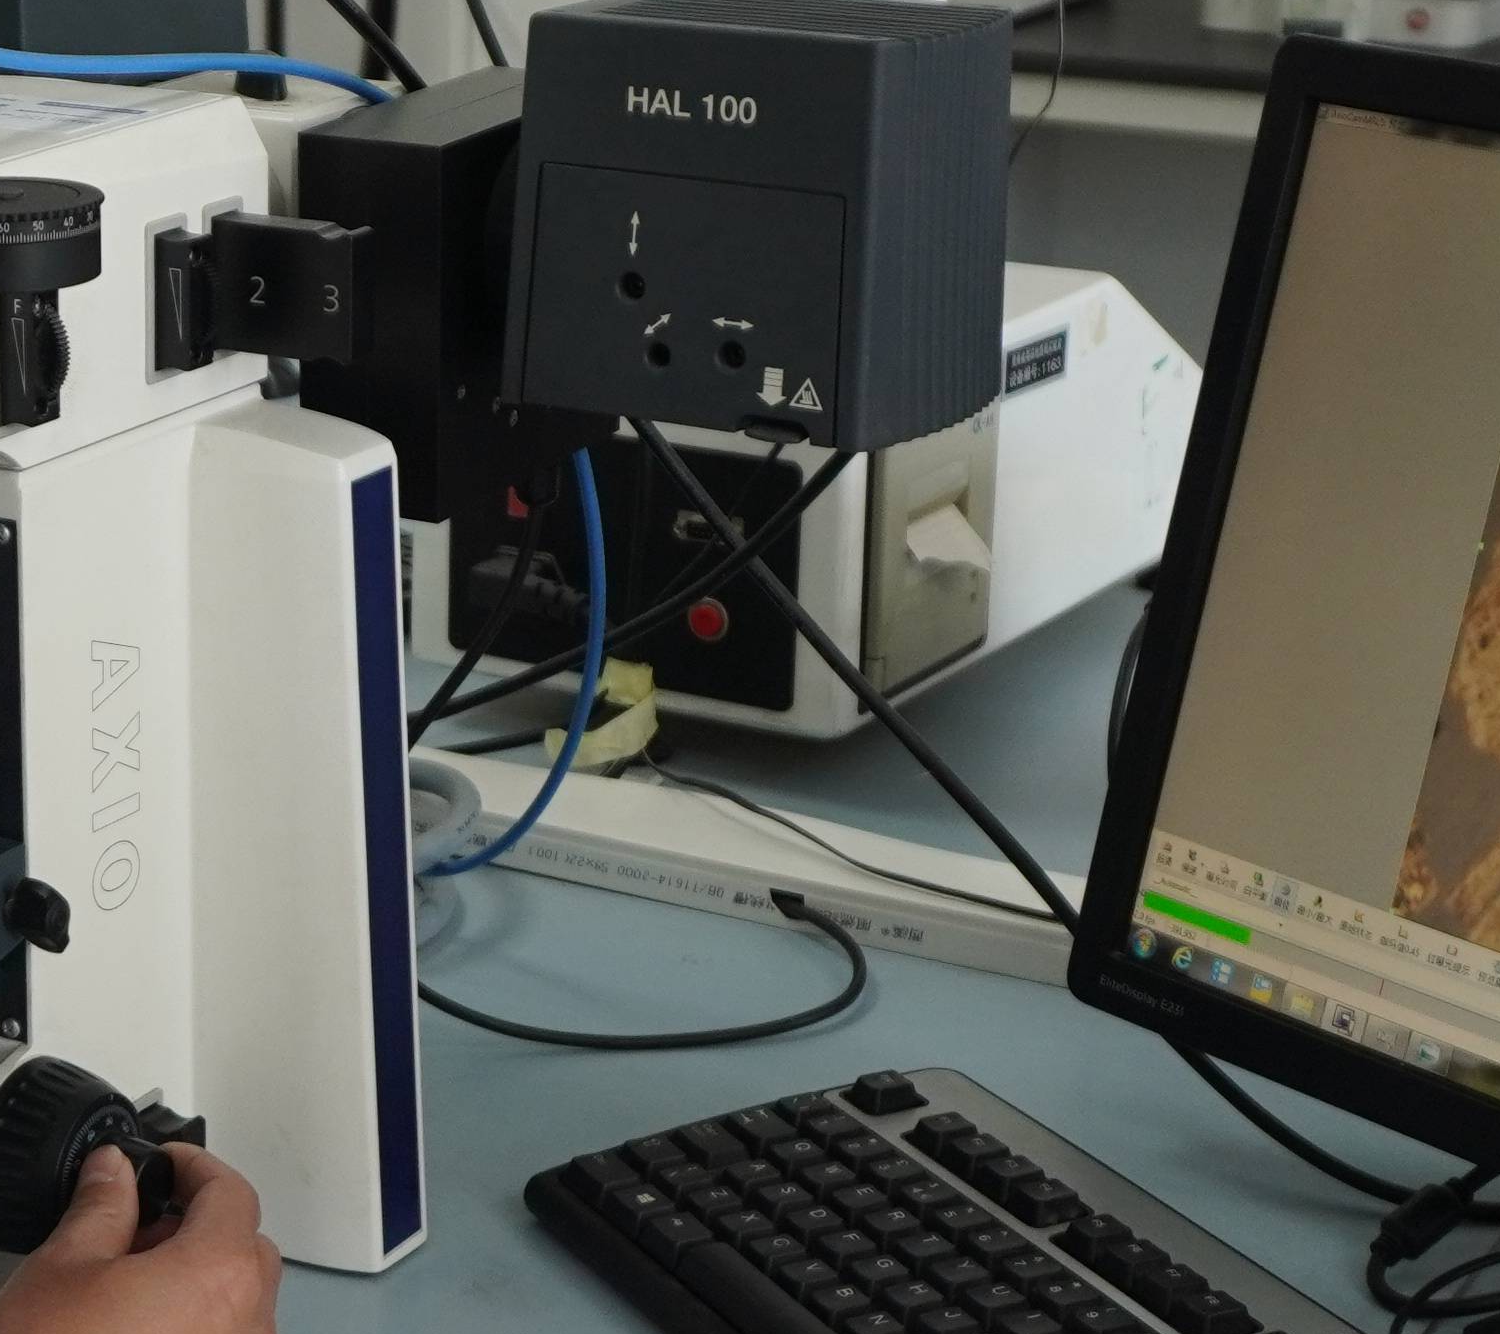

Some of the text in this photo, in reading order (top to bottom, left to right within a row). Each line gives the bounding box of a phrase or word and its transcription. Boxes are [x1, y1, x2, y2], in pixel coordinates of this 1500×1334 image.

[627, 85, 757, 124] HAL 100
[32, 220, 44, 232] 50
[63, 216, 74, 227] 40
[249, 275, 339, 312] 2 3
[13, 298, 23, 314] F
[91, 639, 140, 911] AXIO
[856, 1186, 874, 1197] E
[809, 1208, 827, 1219] D
[843, 1233, 861, 1244] F
[921, 1235, 940, 1245] T
[876, 1258, 894, 1269] G
[836, 1287, 854, 1299] B
[909, 1284, 928, 1296] H
[991, 1285, 1011, 1297] U
[871, 1313, 889, 1327] N
[944, 1310, 961, 1320] J
